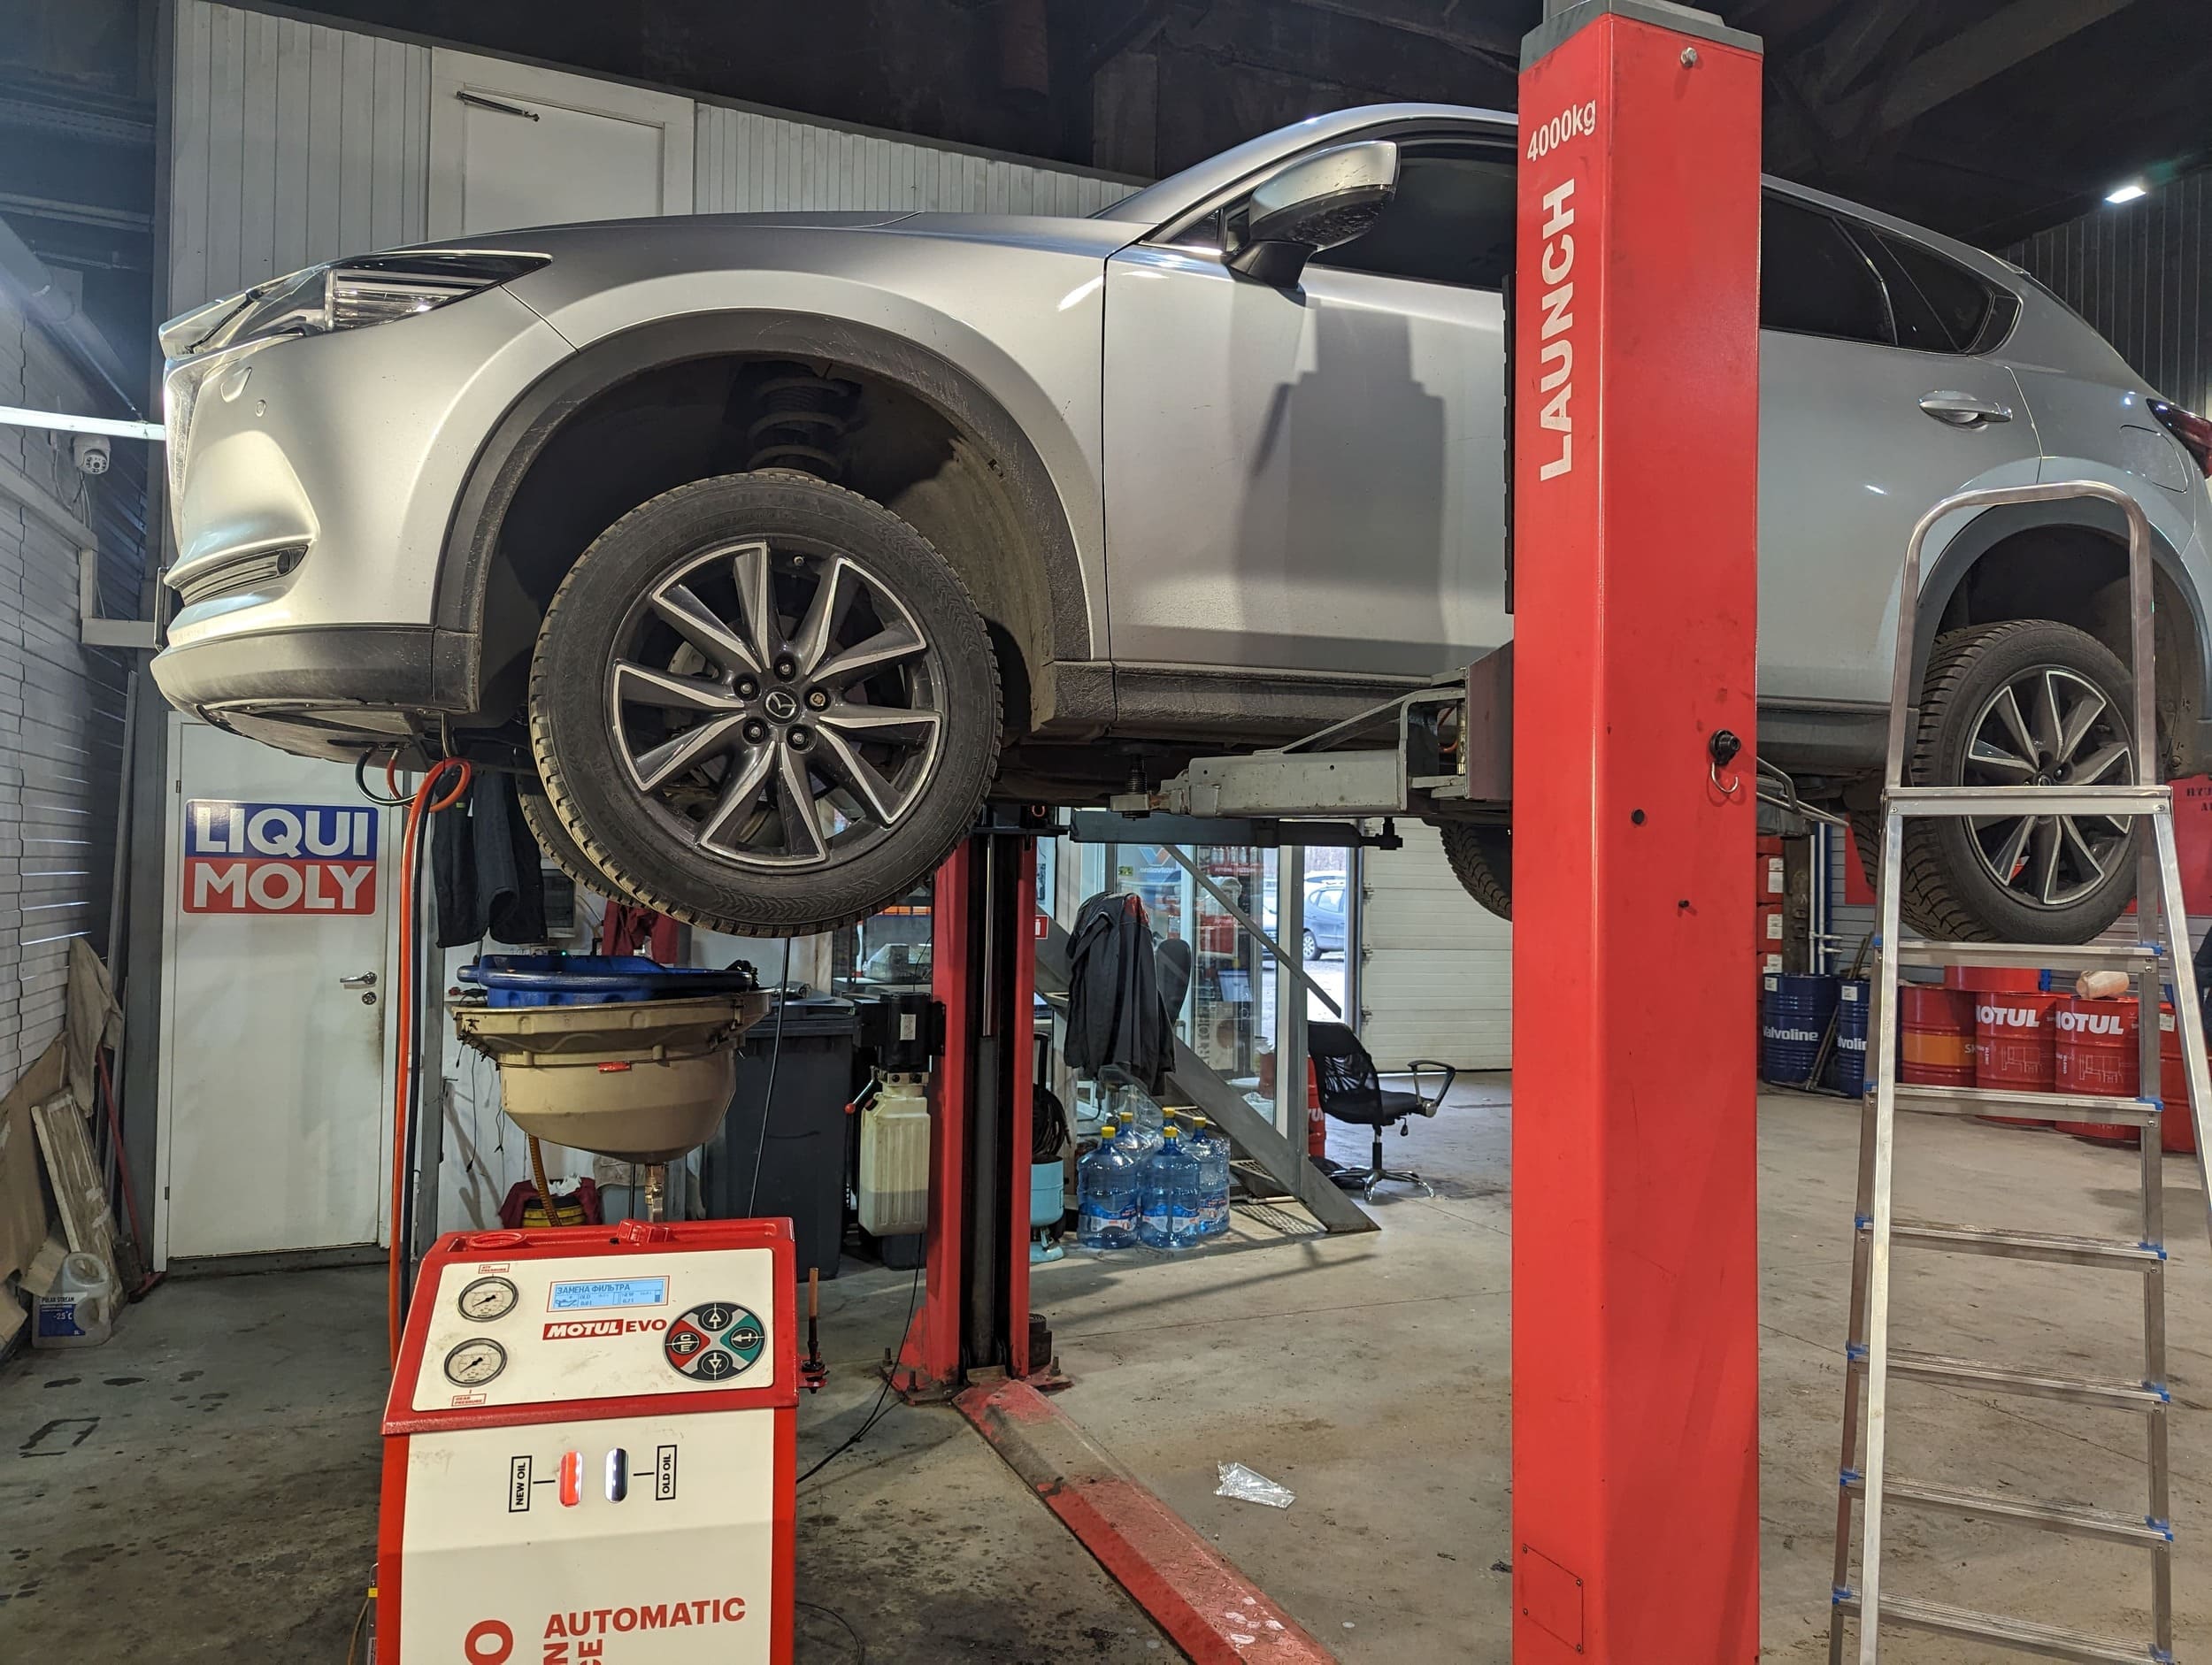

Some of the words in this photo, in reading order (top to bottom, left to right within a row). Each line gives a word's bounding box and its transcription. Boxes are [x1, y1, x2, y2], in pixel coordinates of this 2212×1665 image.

[1526, 99, 1596, 162] 4000kg
[1540, 178, 1575, 481] LAUNCH
[196, 807, 369, 858] LIQUI
[193, 863, 374, 910] MOLY
[557, 1285, 590, 1294] ЗАМЕНА
[591, 1283, 631, 1293] ФИЛЬТРА
[546, 1321, 620, 1339] MOTUL
[625, 1318, 668, 1333] EVO
[518, 1462, 526, 1481] OIL
[662, 1454, 672, 1473] OIL
[515, 1481, 525, 1506] NEW
[662, 1474, 671, 1494] OLD
[543, 1597, 746, 1638] AUTOMATIC
